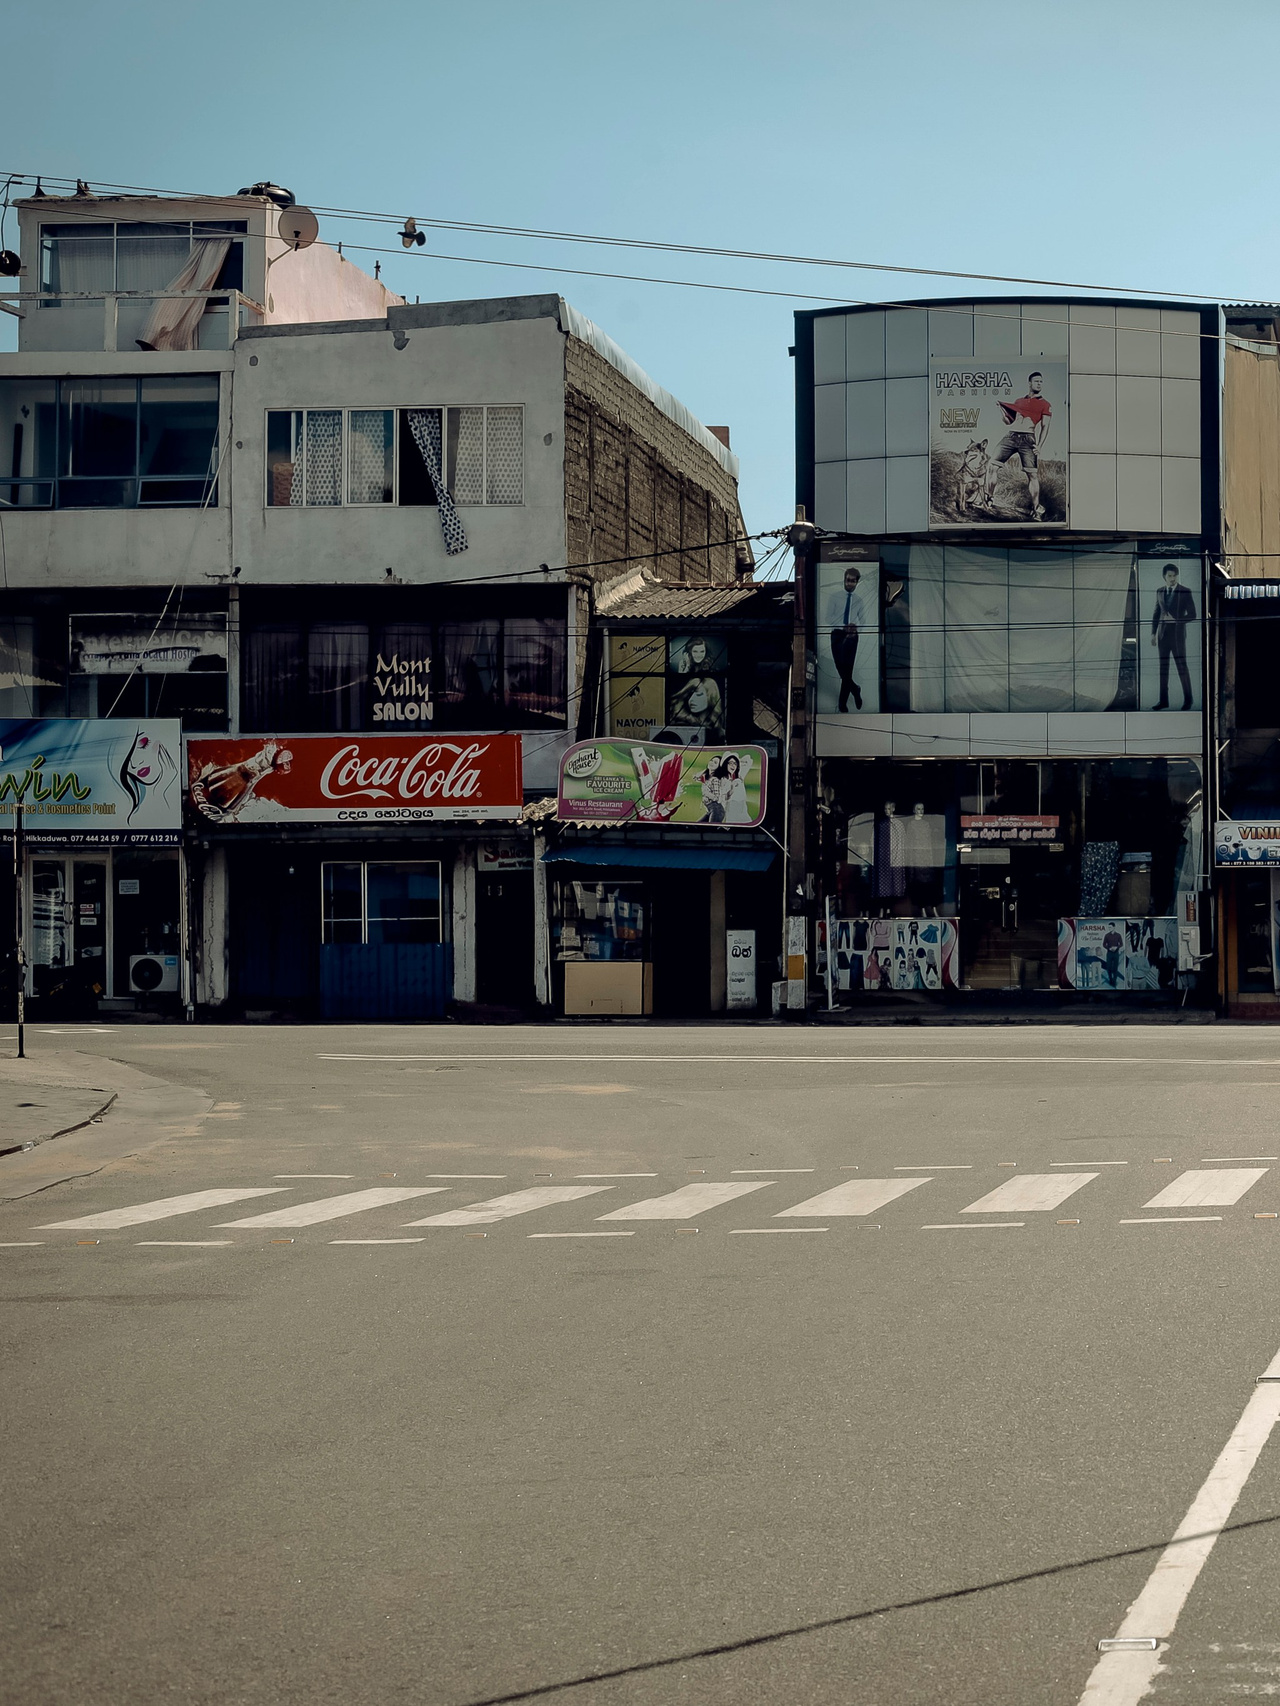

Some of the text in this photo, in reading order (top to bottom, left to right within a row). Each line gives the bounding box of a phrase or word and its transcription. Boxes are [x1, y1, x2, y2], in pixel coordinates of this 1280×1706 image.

[936, 372, 1013, 388] HARSHA
[940, 408, 980, 423] NEW
[376, 653, 432, 674] Mont
[373, 675, 429, 701] Vully
[373, 701, 433, 721] SALON
[616, 718, 656, 727] NAYOMI
[320, 743, 491, 799] Coca-Cola
[573, 760, 593, 774] House
[37, 803, 44, 814] &
[45, 803, 91, 814] Cosmetics
[93, 803, 116, 814] Point
[588, 800, 623, 808] Restaurant
[337, 810, 368, 820] උදය
[731, 945, 752, 958] බත්
